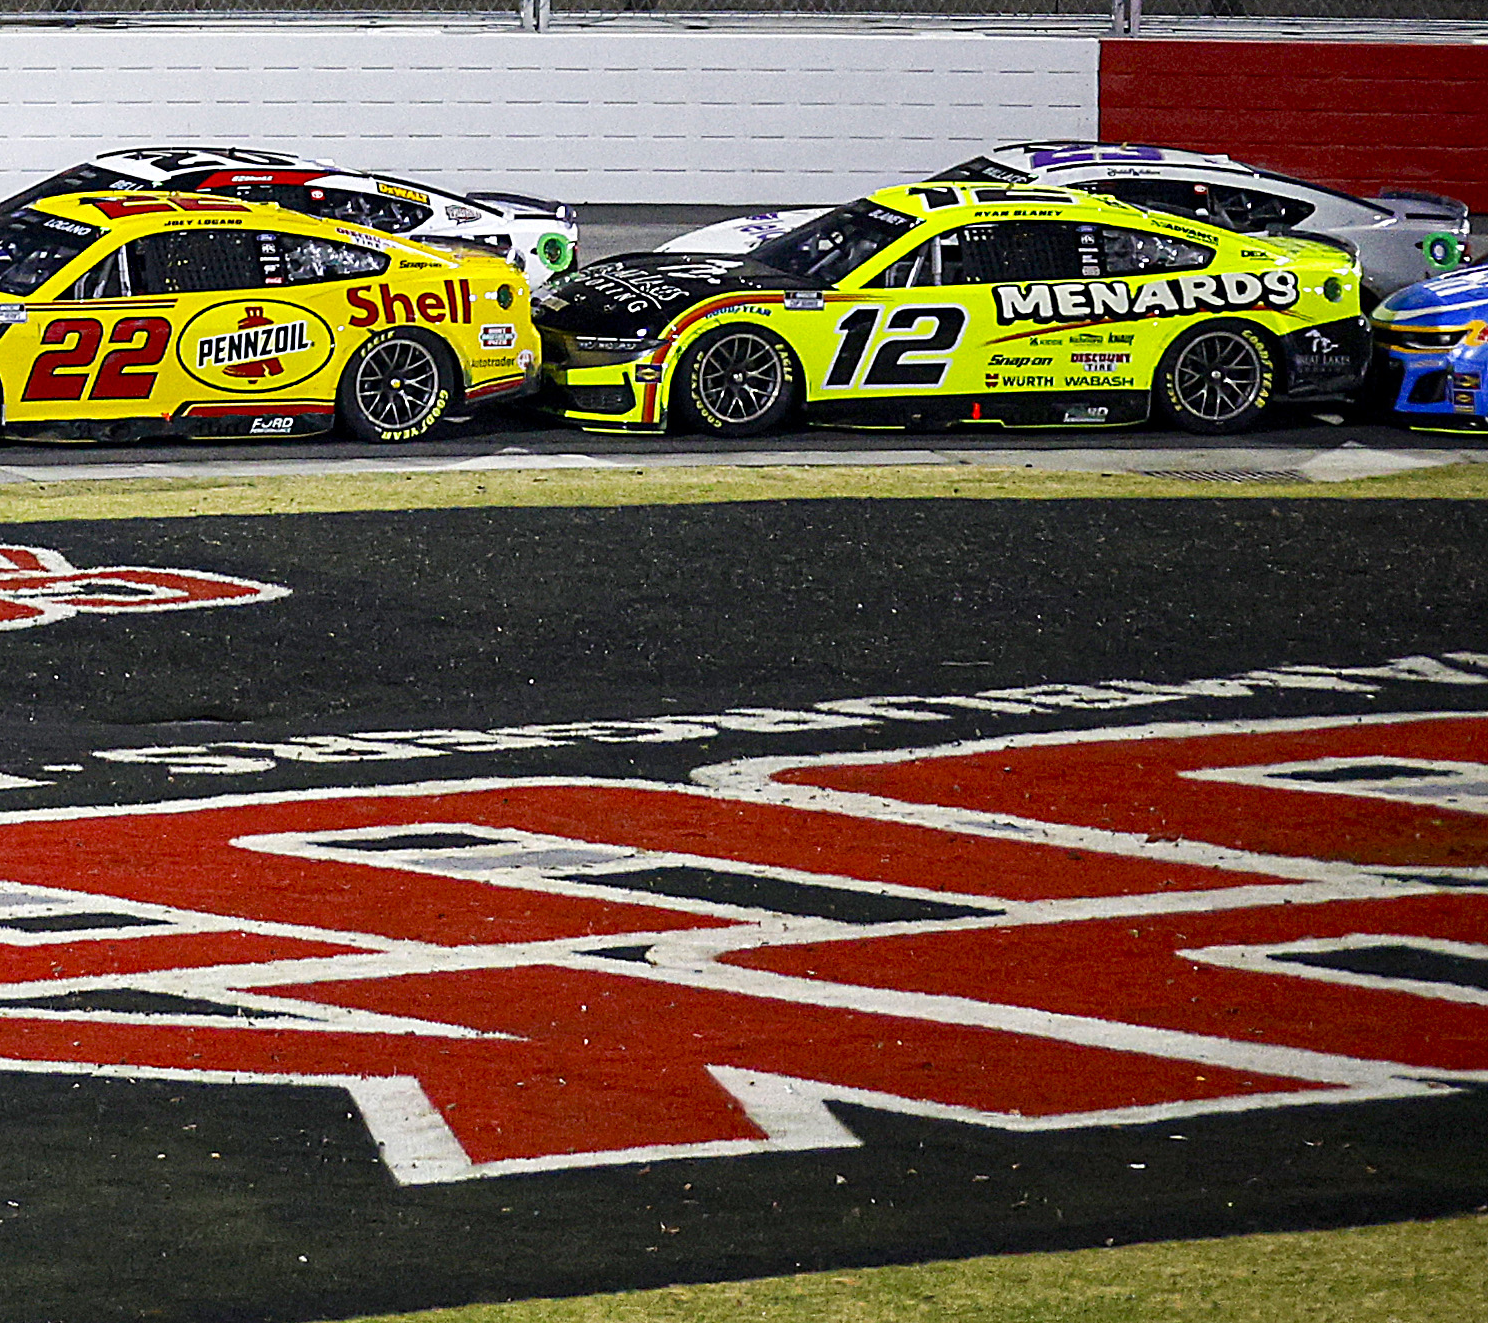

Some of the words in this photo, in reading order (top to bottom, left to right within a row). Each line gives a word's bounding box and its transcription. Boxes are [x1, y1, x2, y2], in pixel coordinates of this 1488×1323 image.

[43, 219, 92, 236] LOGANO
[164, 219, 195, 227] JOEY
[974, 210, 1010, 218] RYAN
[1013, 209, 1063, 218] BLANEY
[346, 278, 473, 327] Shell
[995, 272, 1298, 323] MENARDS
[22, 317, 176, 402] 22
[198, 320, 312, 367] PENNZOIL
[826, 306, 967, 390] 12
[987, 354, 1053, 368] Snap-on
[1064, 375, 1134, 388] WABASH
[94, 648, 1488, 777] AMBURGERS
